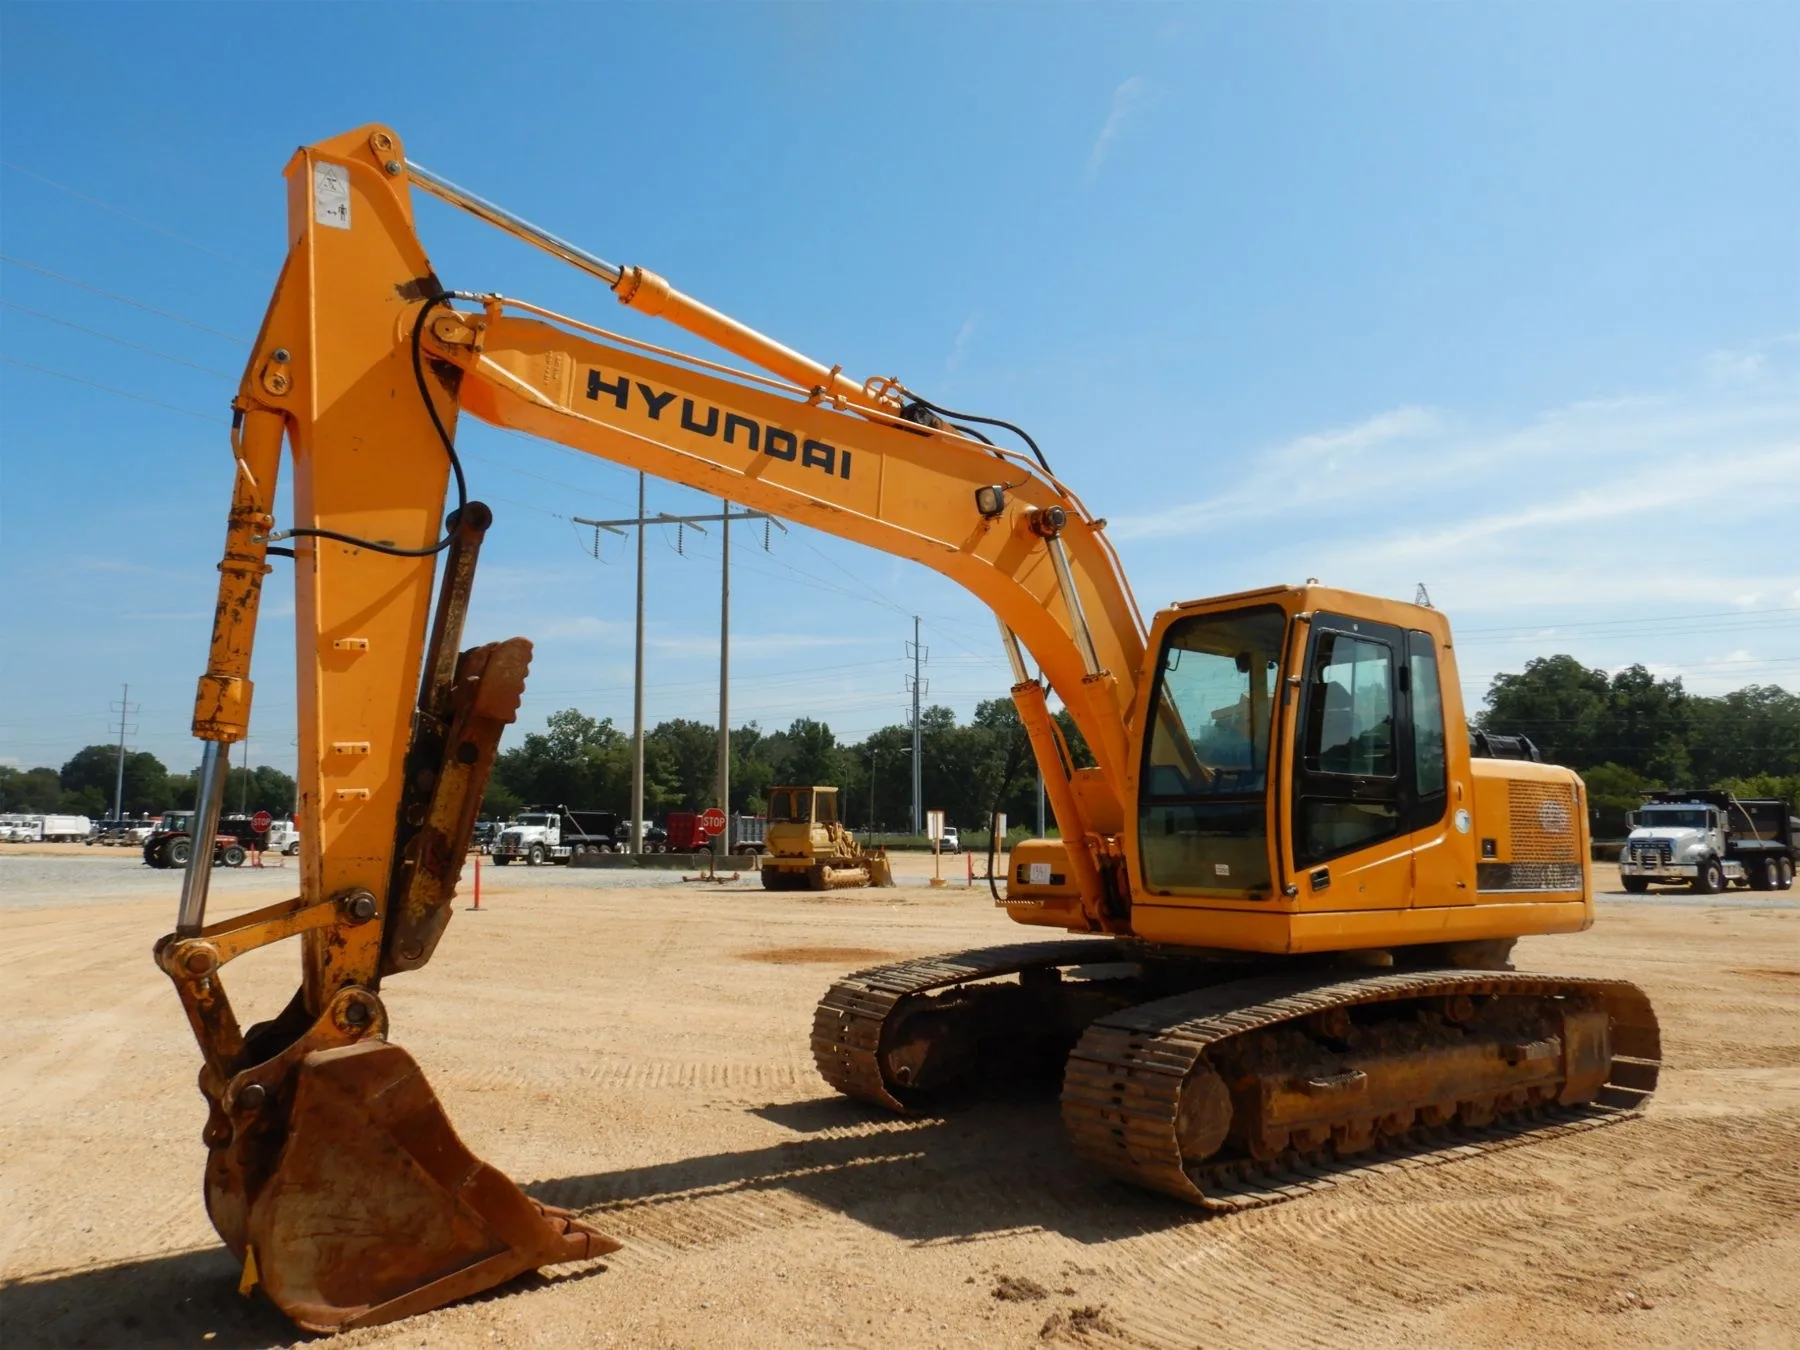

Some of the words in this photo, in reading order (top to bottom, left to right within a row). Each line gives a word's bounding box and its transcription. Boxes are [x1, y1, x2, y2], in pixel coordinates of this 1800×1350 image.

[586, 368, 852, 480] HYUNDAI
[254, 818, 271, 826] STOP
[704, 817, 725, 827] STOP
